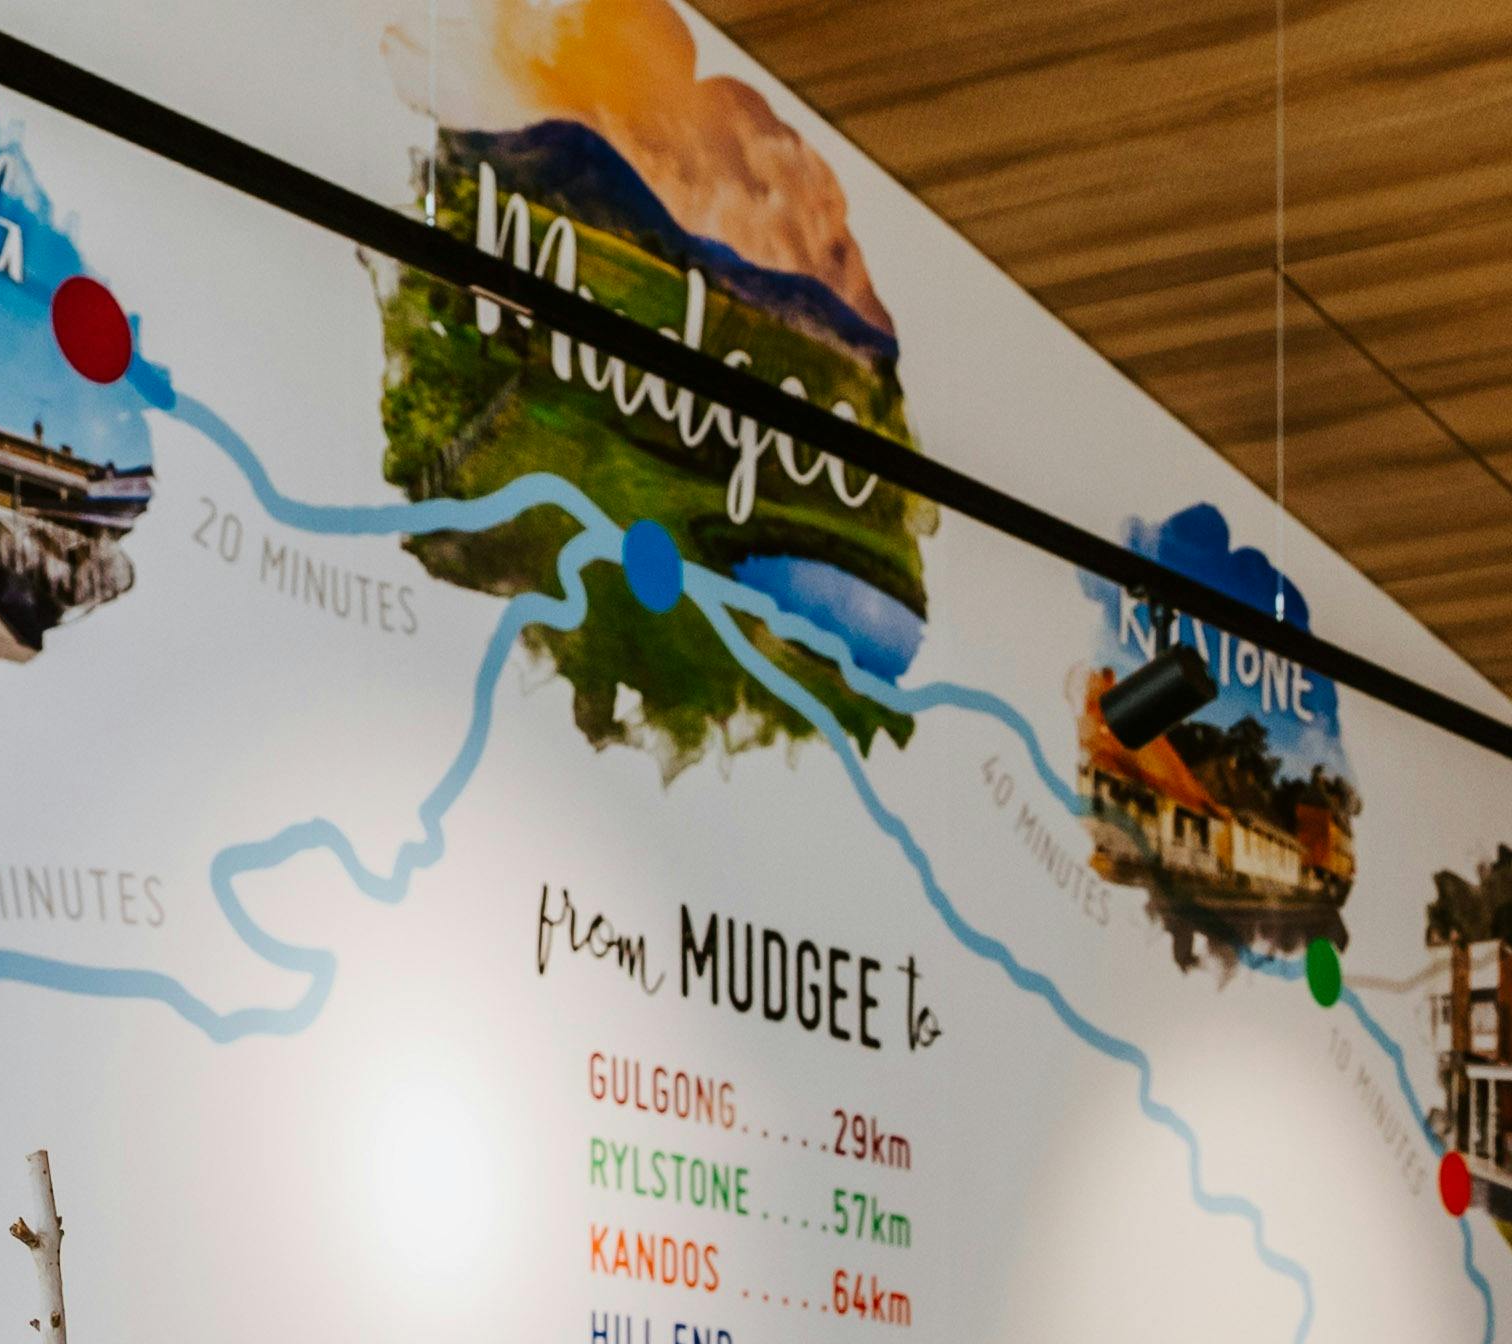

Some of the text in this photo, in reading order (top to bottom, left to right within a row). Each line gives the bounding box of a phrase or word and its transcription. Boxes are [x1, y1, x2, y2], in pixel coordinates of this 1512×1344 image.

[192, 496, 420, 636] 20 MINUTES
[1016, 816, 1111, 925] MINUTES
[536, 882, 943, 1052] from MUDGEE to
[589, 1050, 912, 1170] GULGONG 29km
[589, 1136, 912, 1249] RYLSTONE 57km
[589, 1223, 912, 1328] KANDOS 64km
